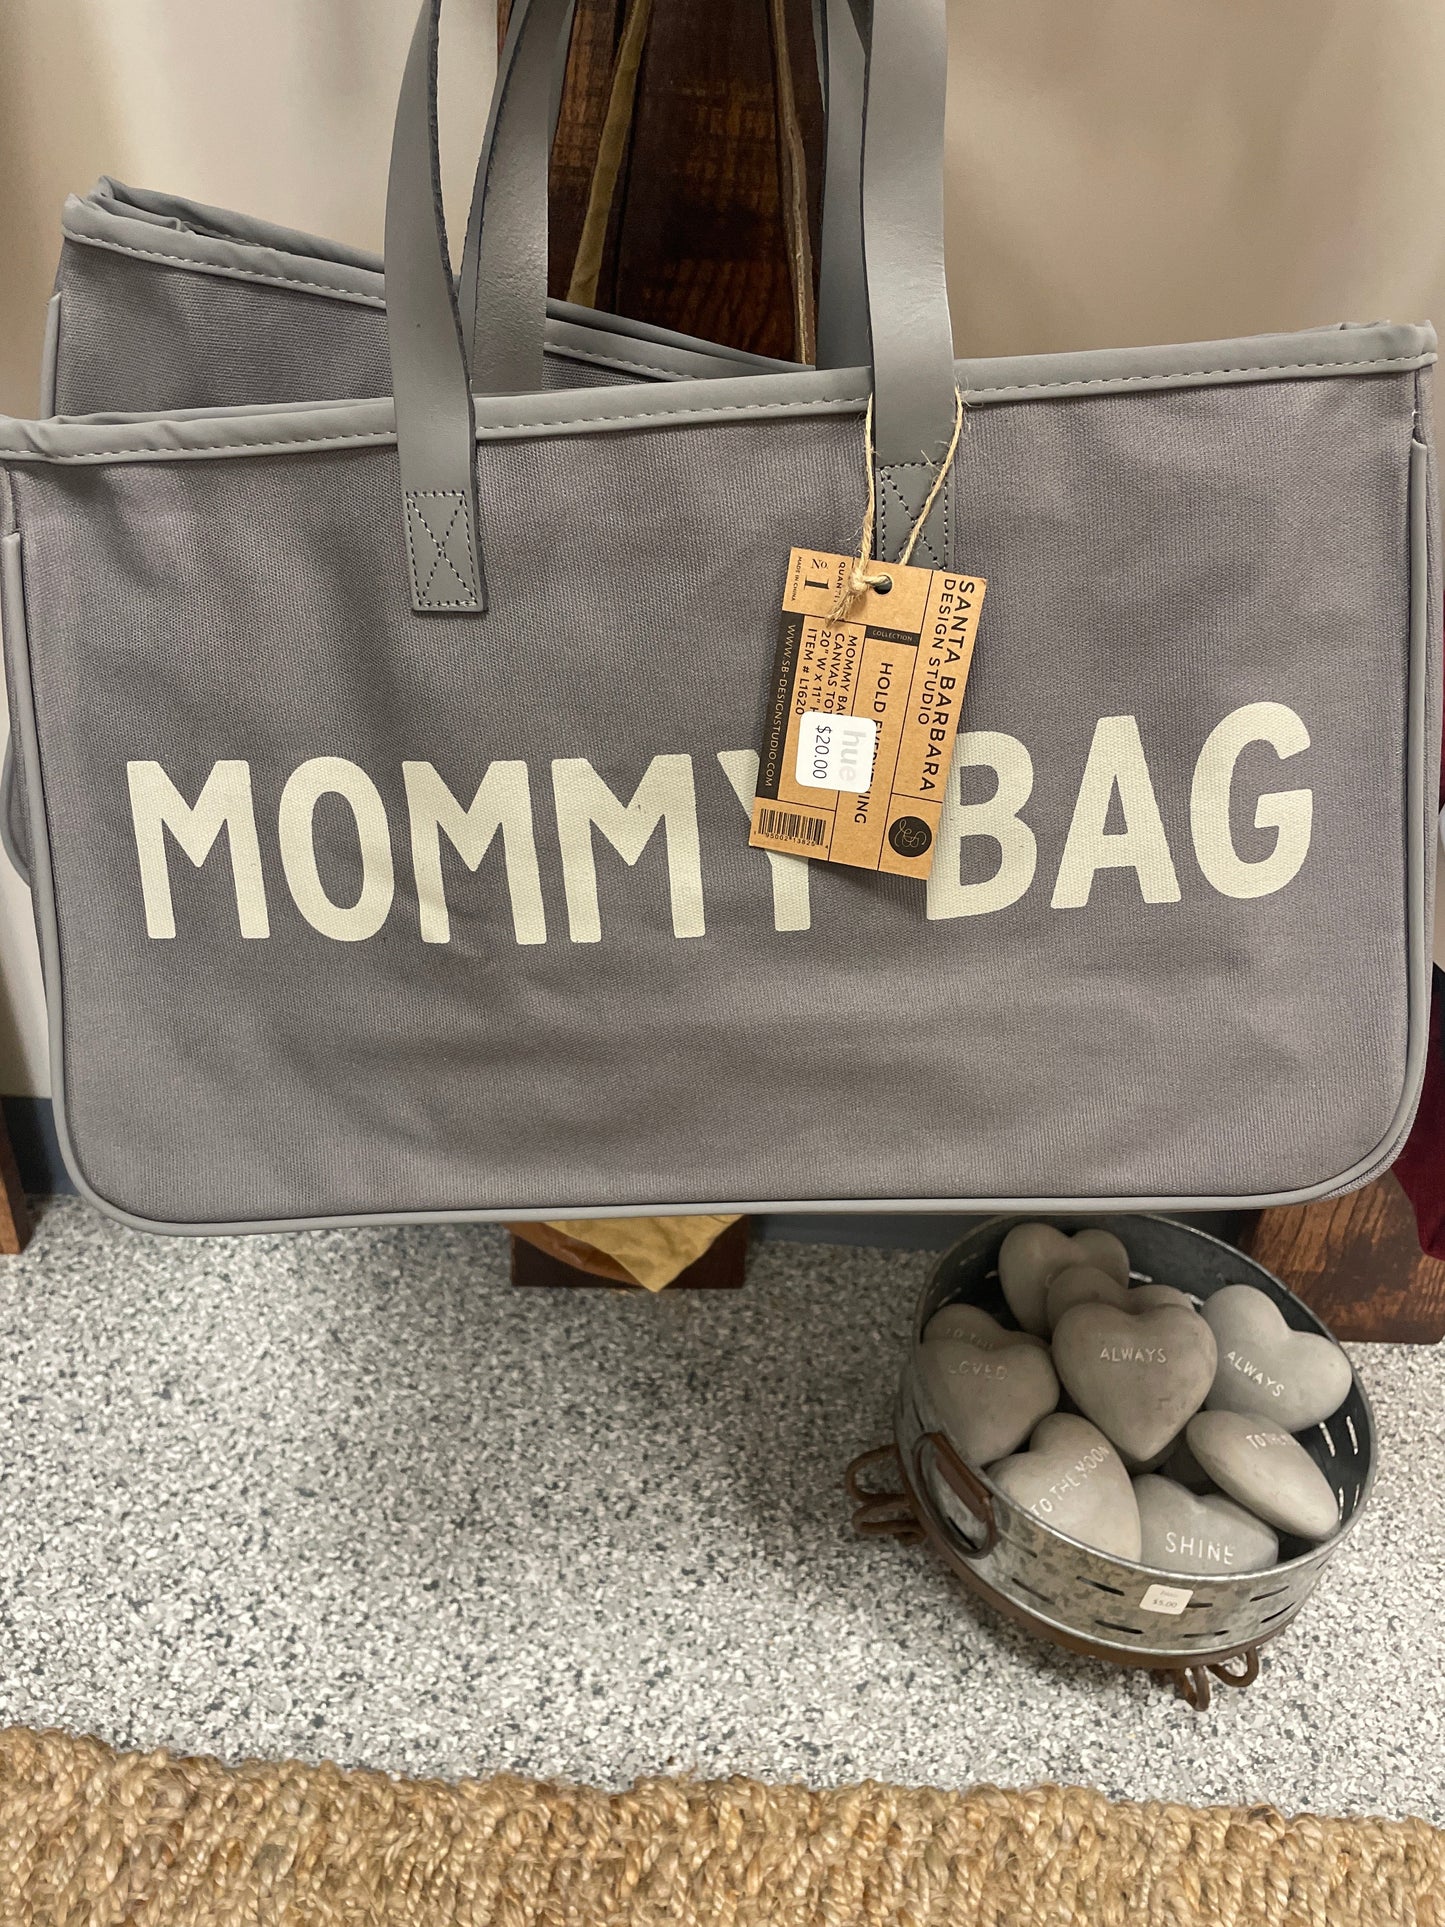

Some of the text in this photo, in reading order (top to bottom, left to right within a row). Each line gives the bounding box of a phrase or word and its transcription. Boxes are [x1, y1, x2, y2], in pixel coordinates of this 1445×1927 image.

[791, 582, 799, 601] CHINA
[804, 574, 830, 590] 1
[833, 561, 846, 603] QUANTI
[803, 628, 818, 661] ITEM
[872, 630, 913, 642] COLLECTION
[917, 578, 957, 726] DESIGN STUDIO
[802, 665, 810, 673] #
[816, 657, 827, 671] W
[823, 633, 845, 714] CANVAS TOT
[840, 635, 858, 692] MOMMY
[919, 580, 976, 791] SANTA BARBARA
[873, 662, 894, 714] HOLD
[812, 724, 833, 780] $20.00
[839, 729, 867, 783] hue
[926, 701, 1313, 921] BAG
[1099, 1347, 1167, 1364] ALWAYS
[1225, 1350, 1285, 1397] ALWAYS
[1029, 1497, 1053, 1520] TO
[1049, 1472, 1081, 1502] THE
[1165, 1531, 1235, 1566] SHINE
